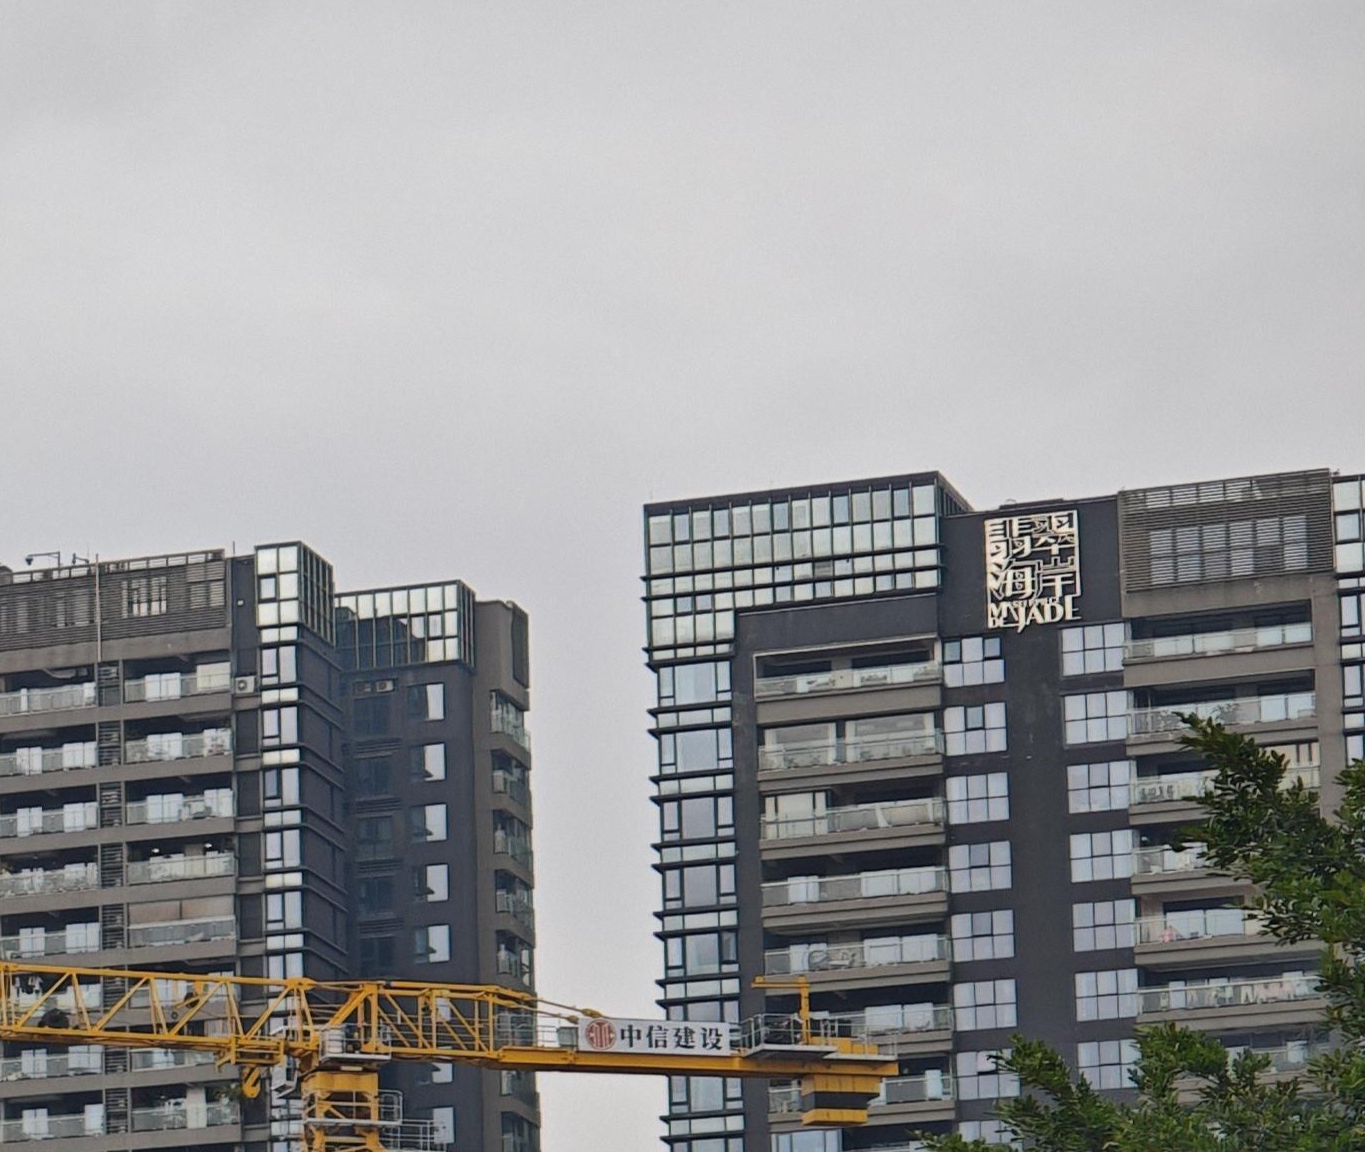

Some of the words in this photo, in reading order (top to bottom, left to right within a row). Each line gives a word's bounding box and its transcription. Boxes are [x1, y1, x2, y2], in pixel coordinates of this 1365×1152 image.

[986, 556, 1081, 600] 海岸
[1018, 595, 1082, 633] JADE
[620, 1023, 723, 1050] 中信建设
